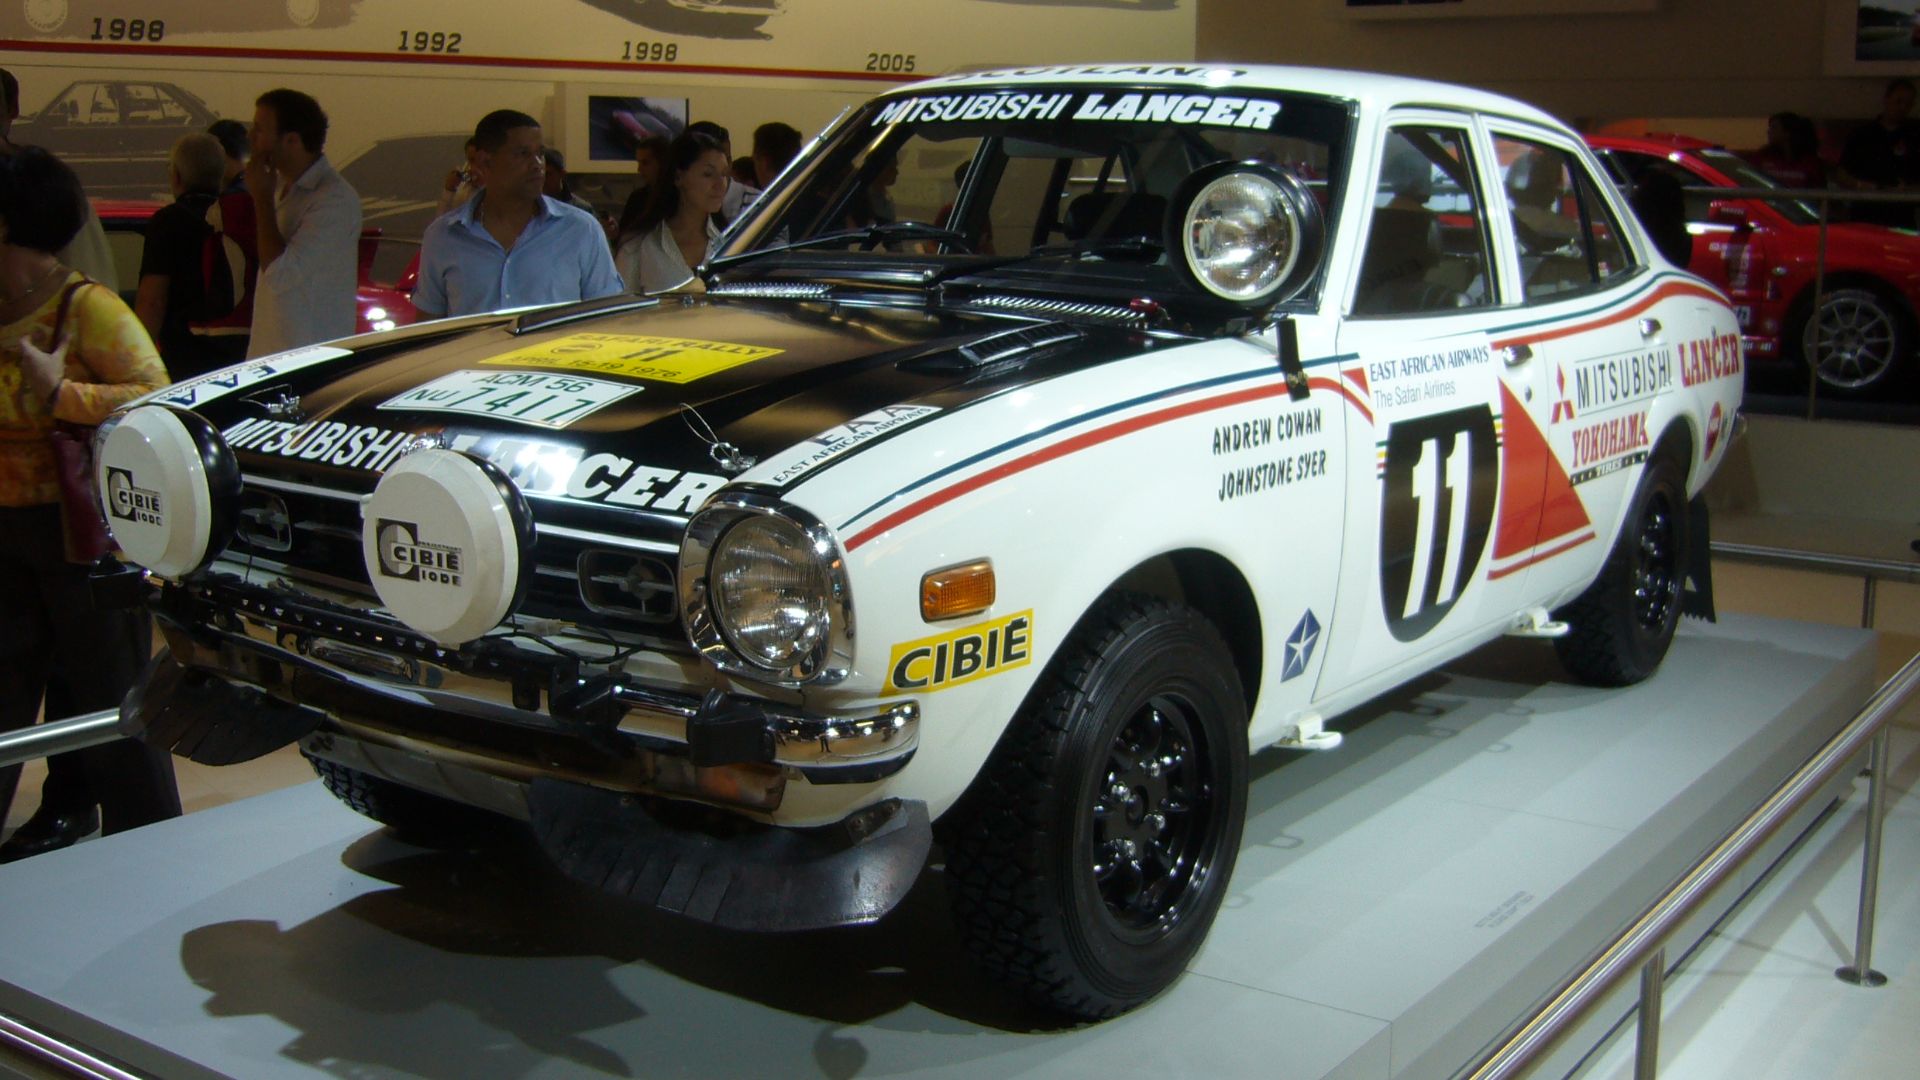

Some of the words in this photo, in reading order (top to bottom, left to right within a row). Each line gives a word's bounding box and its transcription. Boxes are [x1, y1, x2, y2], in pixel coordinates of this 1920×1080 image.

[90, 18, 164, 42] 1988
[397, 30, 461, 53] 1992
[621, 41, 678, 63] 1998
[866, 52, 917, 74] 2005
[872, 93, 1073, 127] MITSUBISHI
[1073, 94, 1281, 129] LANCER
[621, 347, 679, 362] 11
[671, 342, 764, 355] RALLY
[1369, 361, 1398, 381] EAST
[1400, 352, 1444, 379] AFRICAN
[1445, 346, 1490, 368] AIRWAYS
[1678, 334, 1740, 388] LANCER
[477, 373, 540, 388] ACM
[545, 378, 590, 393] 56
[567, 359, 625, 370] 15-19
[628, 365, 682, 378] 1976
[1575, 350, 1672, 409] MITSUBISHI
[405, 388, 458, 402] NU
[446, 387, 597, 422] 7417
[1374, 391, 1392, 408] The
[1394, 384, 1423, 404] Safari
[1425, 379, 1457, 399] Airlines
[222, 417, 416, 472] MITSUBISHI
[772, 461, 811, 483] EAST
[812, 431, 873, 462] AFRICAN
[874, 408, 932, 433] AIRWAYS
[1213, 418, 1272, 456] ANDREW
[1276, 408, 1322, 441] COWAN
[1572, 411, 1649, 469] YOKOHAMA
[1218, 457, 1294, 502] JOHNSTONE
[1296, 449, 1327, 481] SYER
[1597, 458, 1623, 477] TIRES
[1403, 431, 1470, 618] 11
[421, 570, 462, 588] IODE
